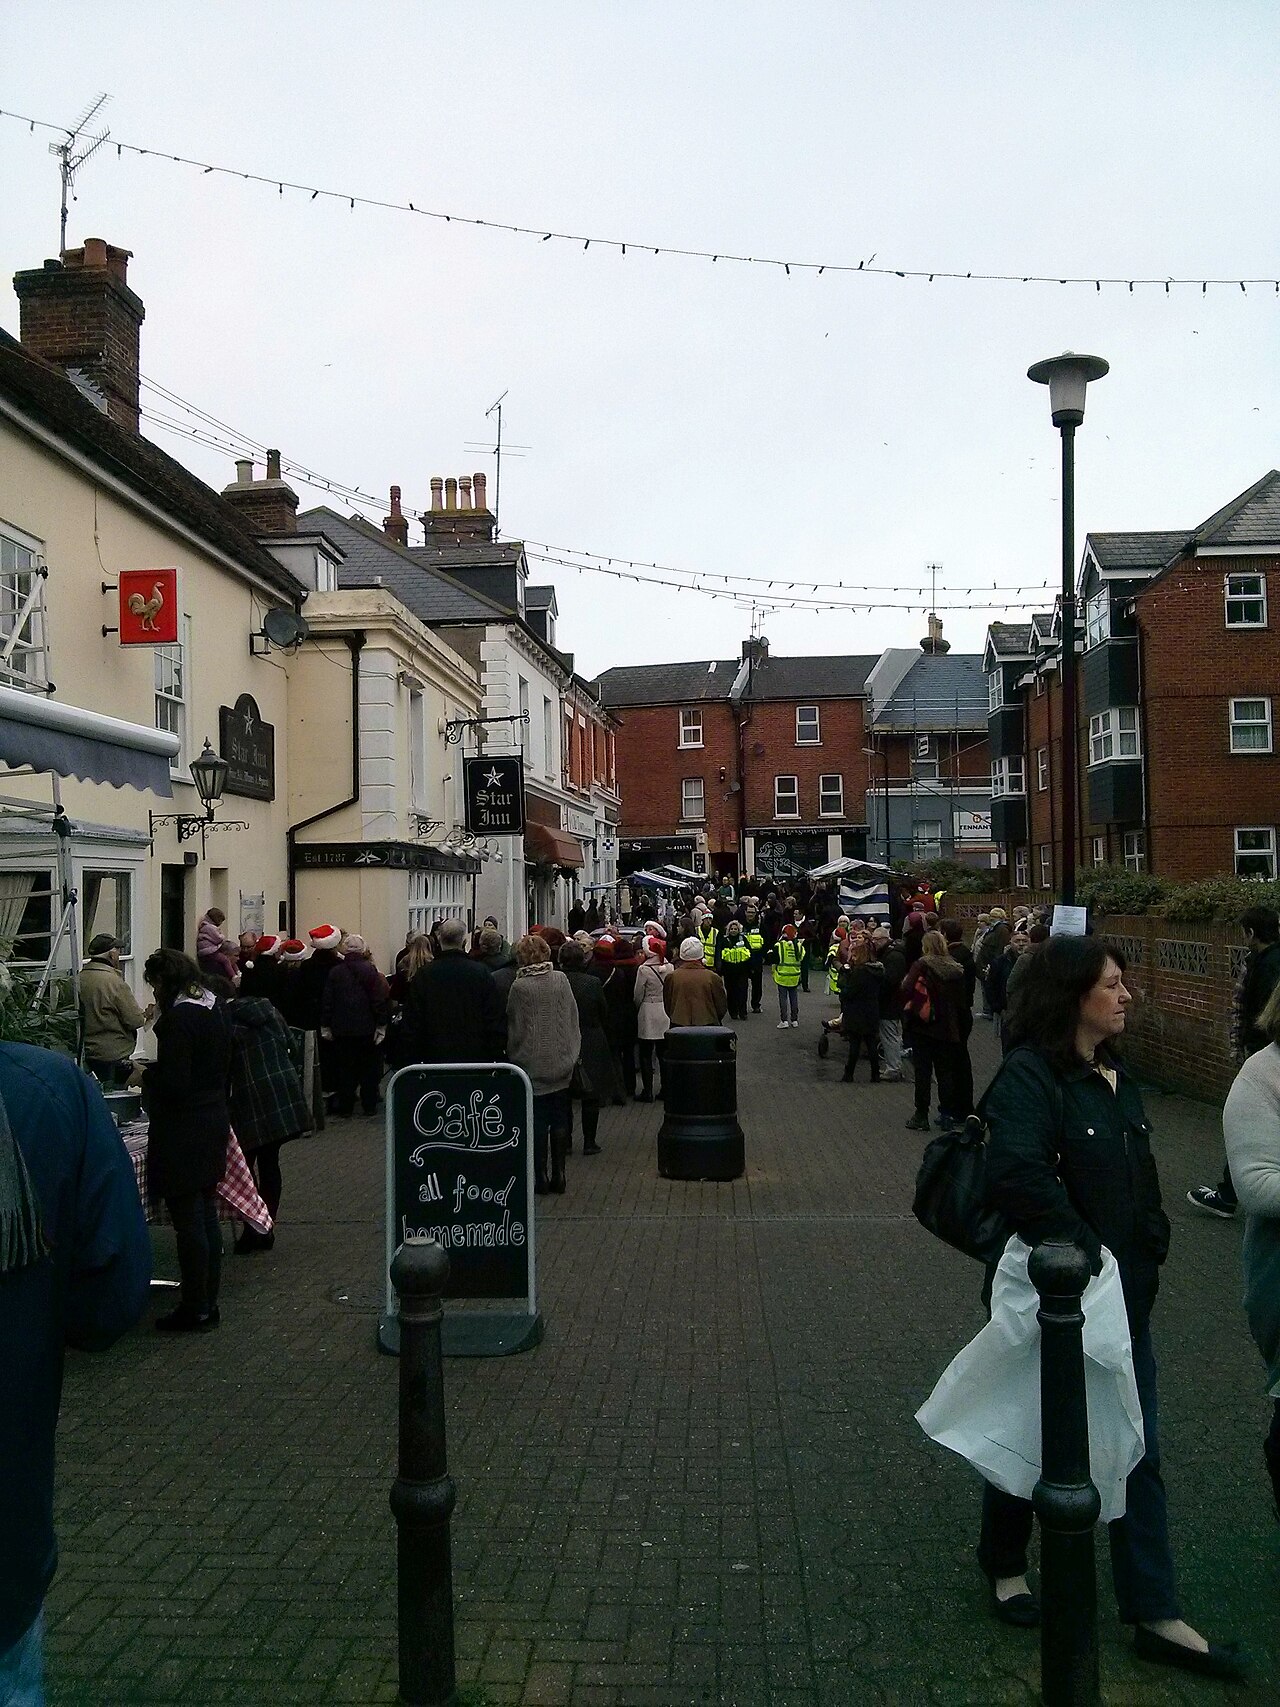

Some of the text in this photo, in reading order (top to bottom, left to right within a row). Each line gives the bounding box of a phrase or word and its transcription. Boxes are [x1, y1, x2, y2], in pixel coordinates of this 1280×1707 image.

[231, 737, 267, 768] Star Inn
[475, 789, 514, 806] Star
[478, 809, 511, 826] Inn
[413, 1089, 506, 1148] Café
[418, 1172, 517, 1213] all food
[402, 1209, 525, 1248] homemade
